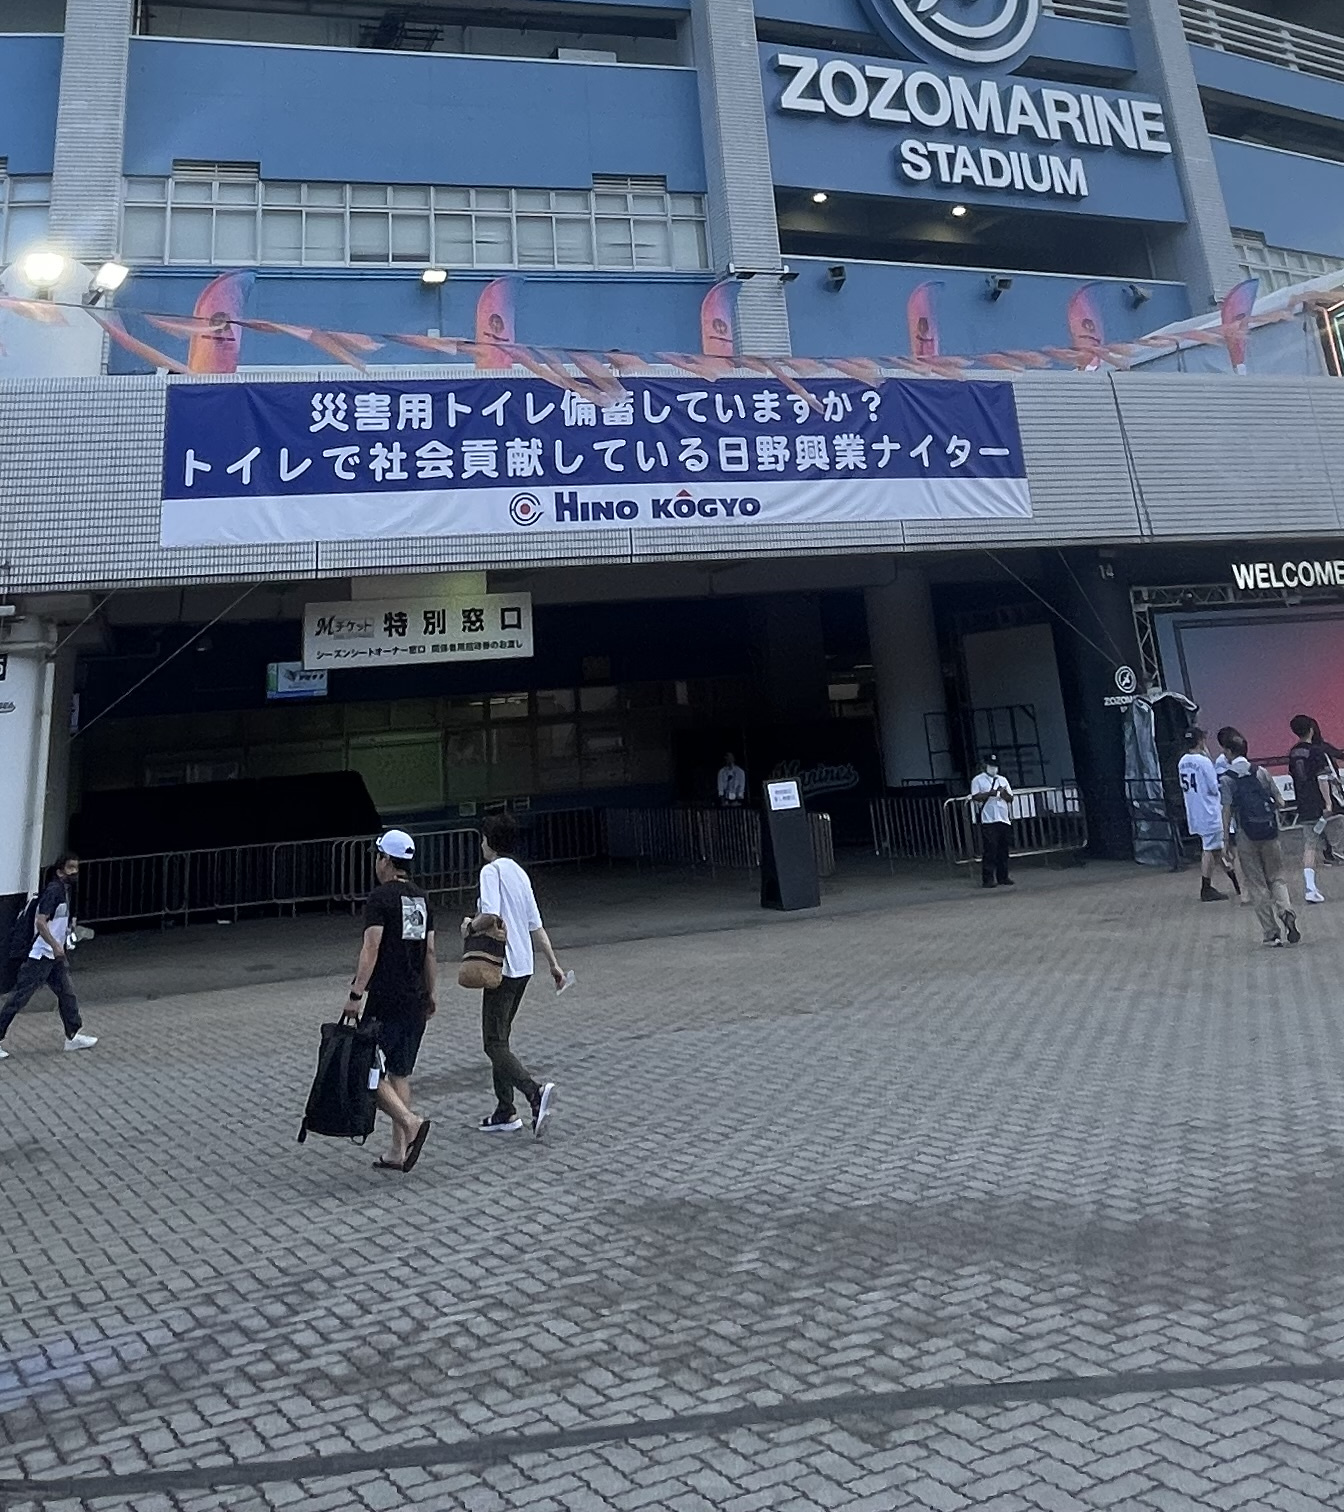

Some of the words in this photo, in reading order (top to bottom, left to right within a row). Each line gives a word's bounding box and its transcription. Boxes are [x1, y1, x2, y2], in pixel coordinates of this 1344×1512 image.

[775, 53, 1172, 155] ZOZOMARINE
[899, 138, 1089, 197] STADIUM
[184, 433, 1010, 487] トイレで社会貢献している日野興業ナイター
[554, 491, 639, 522] HINO
[383, 606, 523, 637] 特別窓口
[1180, 773, 1198, 793] 54
